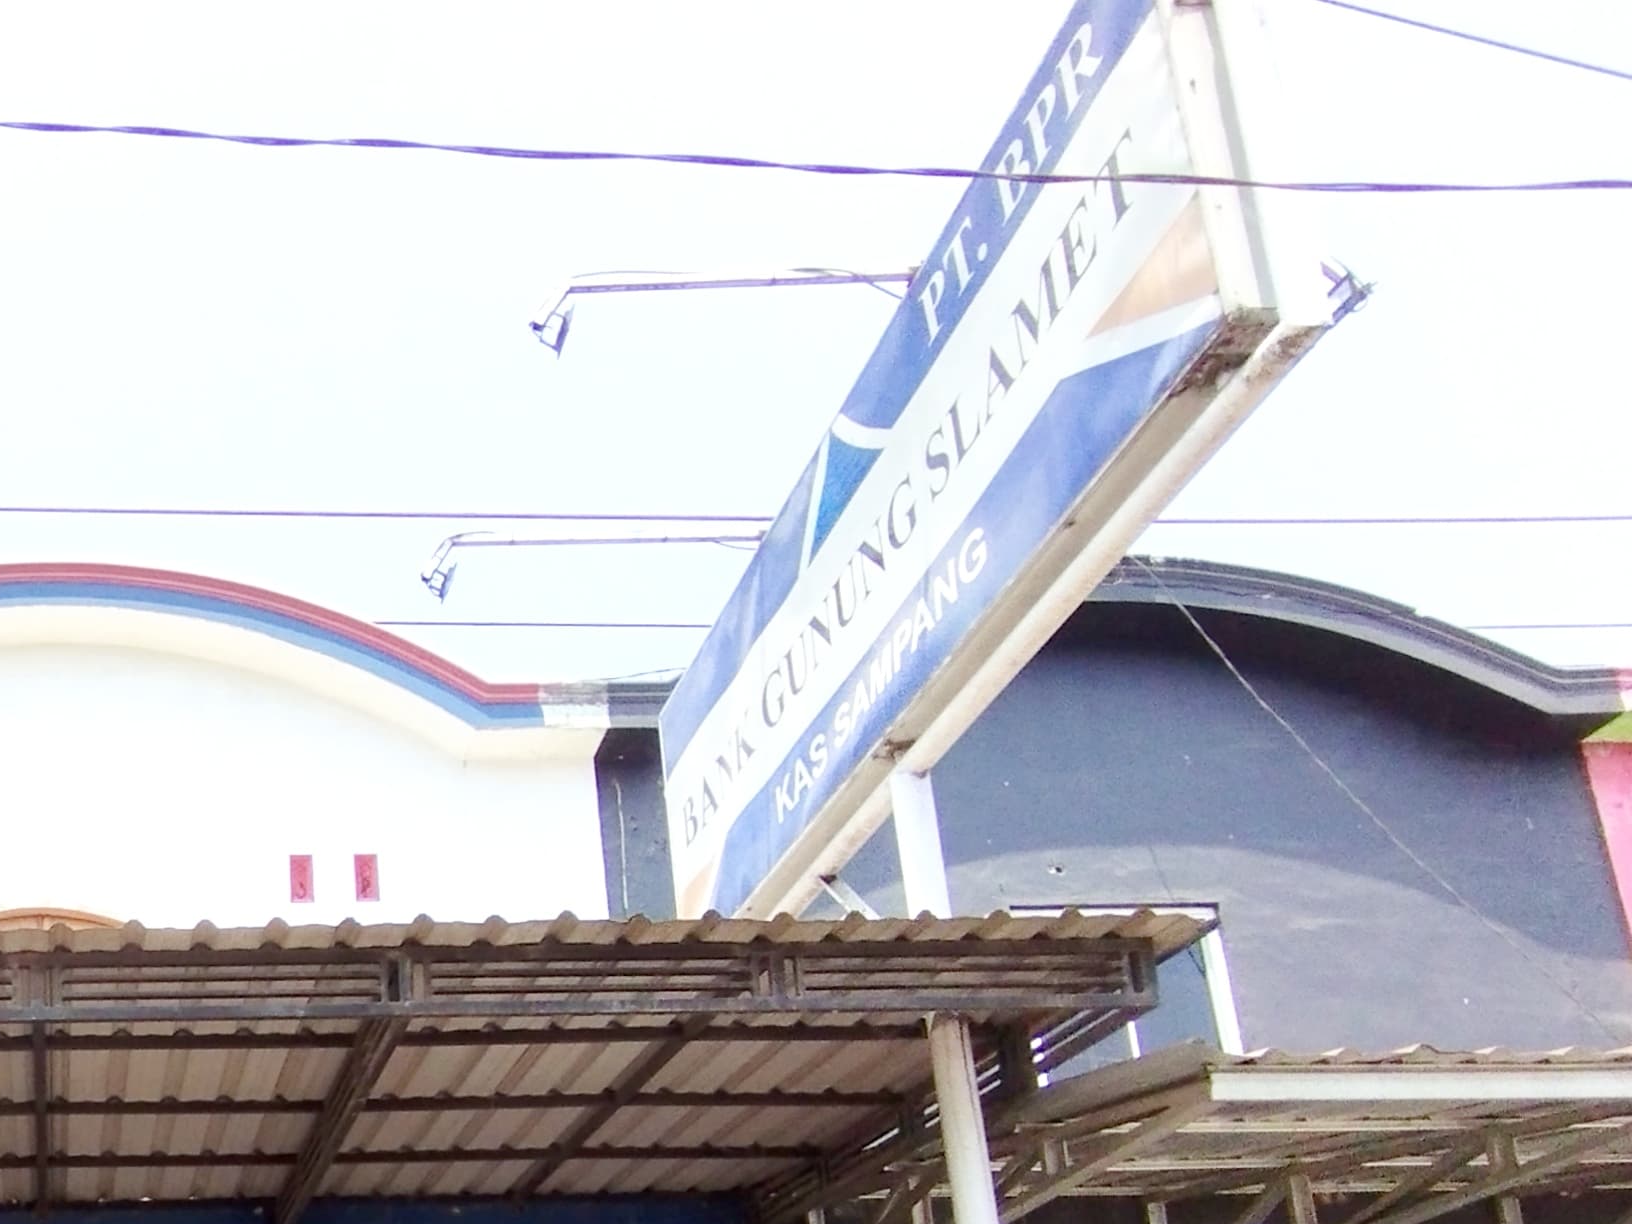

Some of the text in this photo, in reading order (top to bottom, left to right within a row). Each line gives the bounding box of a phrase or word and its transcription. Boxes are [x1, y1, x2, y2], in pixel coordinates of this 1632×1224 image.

[918, 22, 1103, 348] PT. BPR
[681, 126, 1134, 849] BANK GUNUNG SLAMET
[773, 527, 988, 824] KAS SAMPANG
